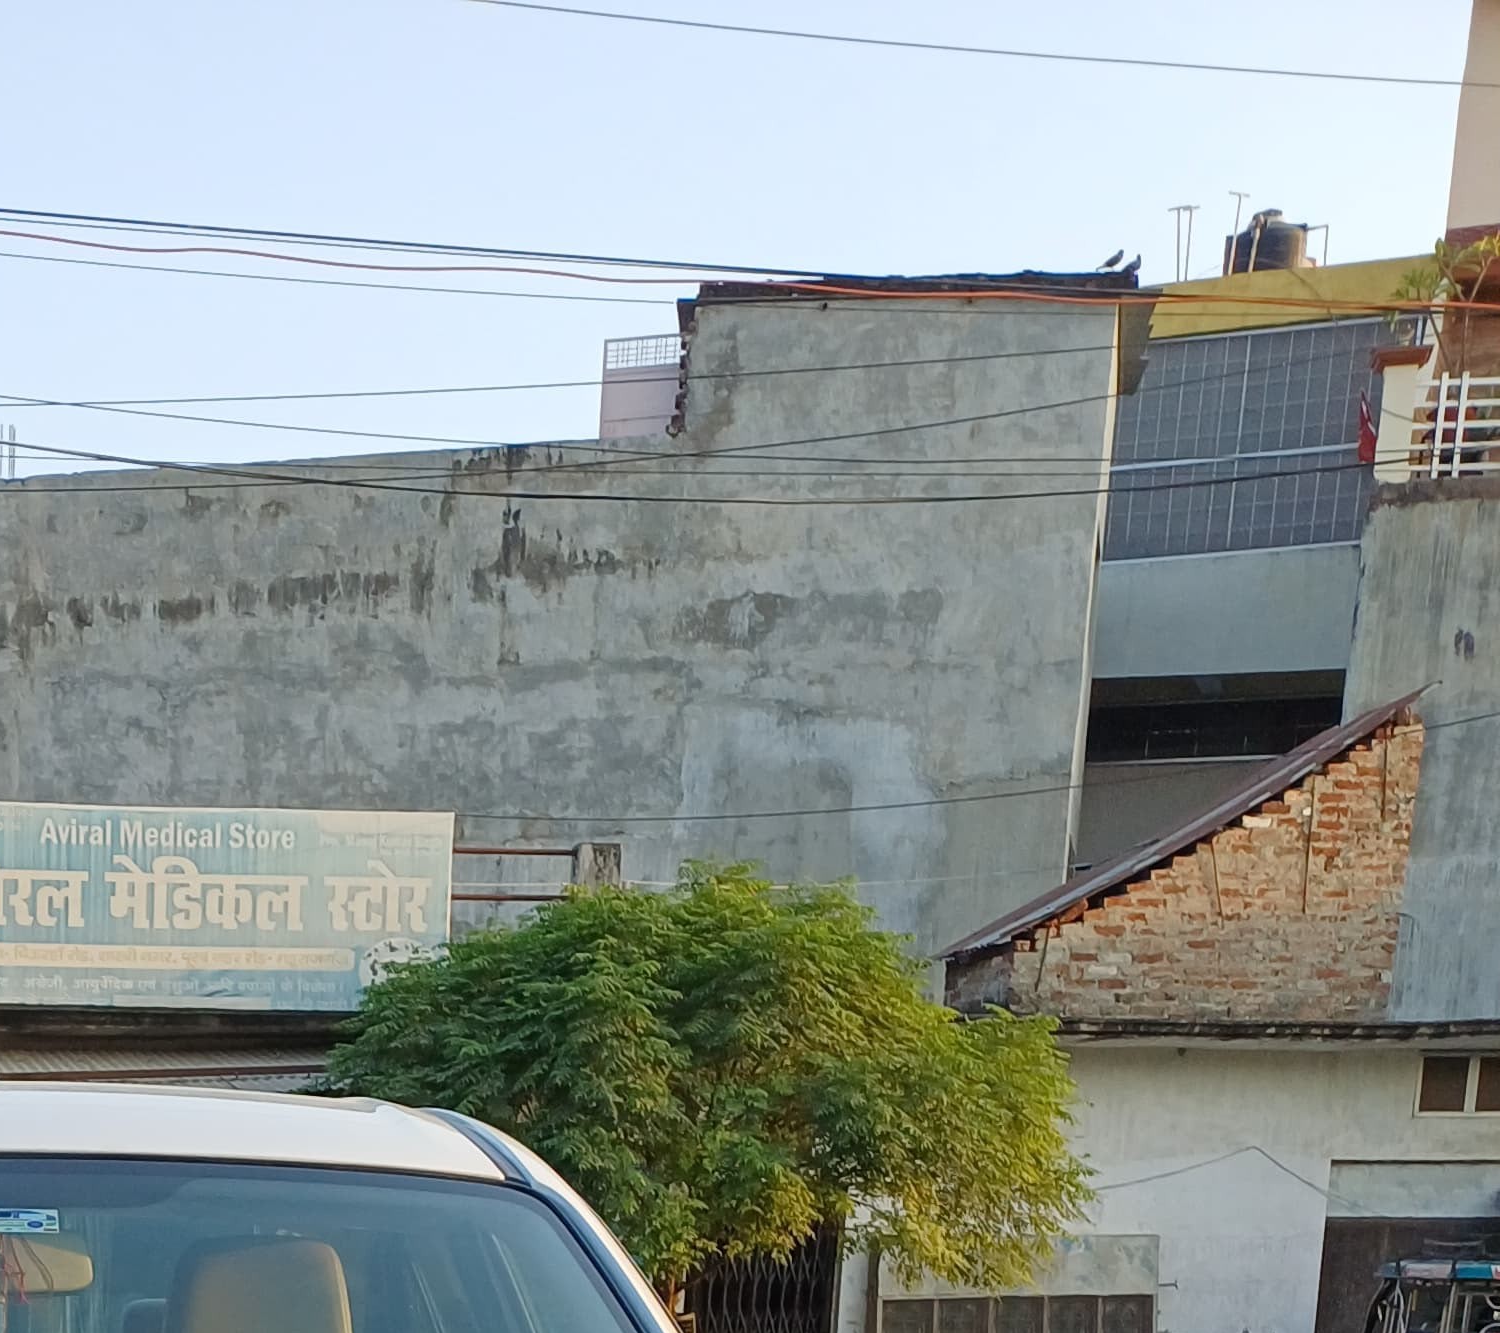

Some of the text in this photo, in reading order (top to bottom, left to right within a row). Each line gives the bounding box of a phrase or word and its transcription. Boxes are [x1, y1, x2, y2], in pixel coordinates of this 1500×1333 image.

[40, 817, 112, 848] Aviral
[119, 819, 221, 849] Medical
[228, 822, 295, 849] Store
[104, 854, 309, 932] मेडिकल
[323, 859, 434, 933] स्टोर
